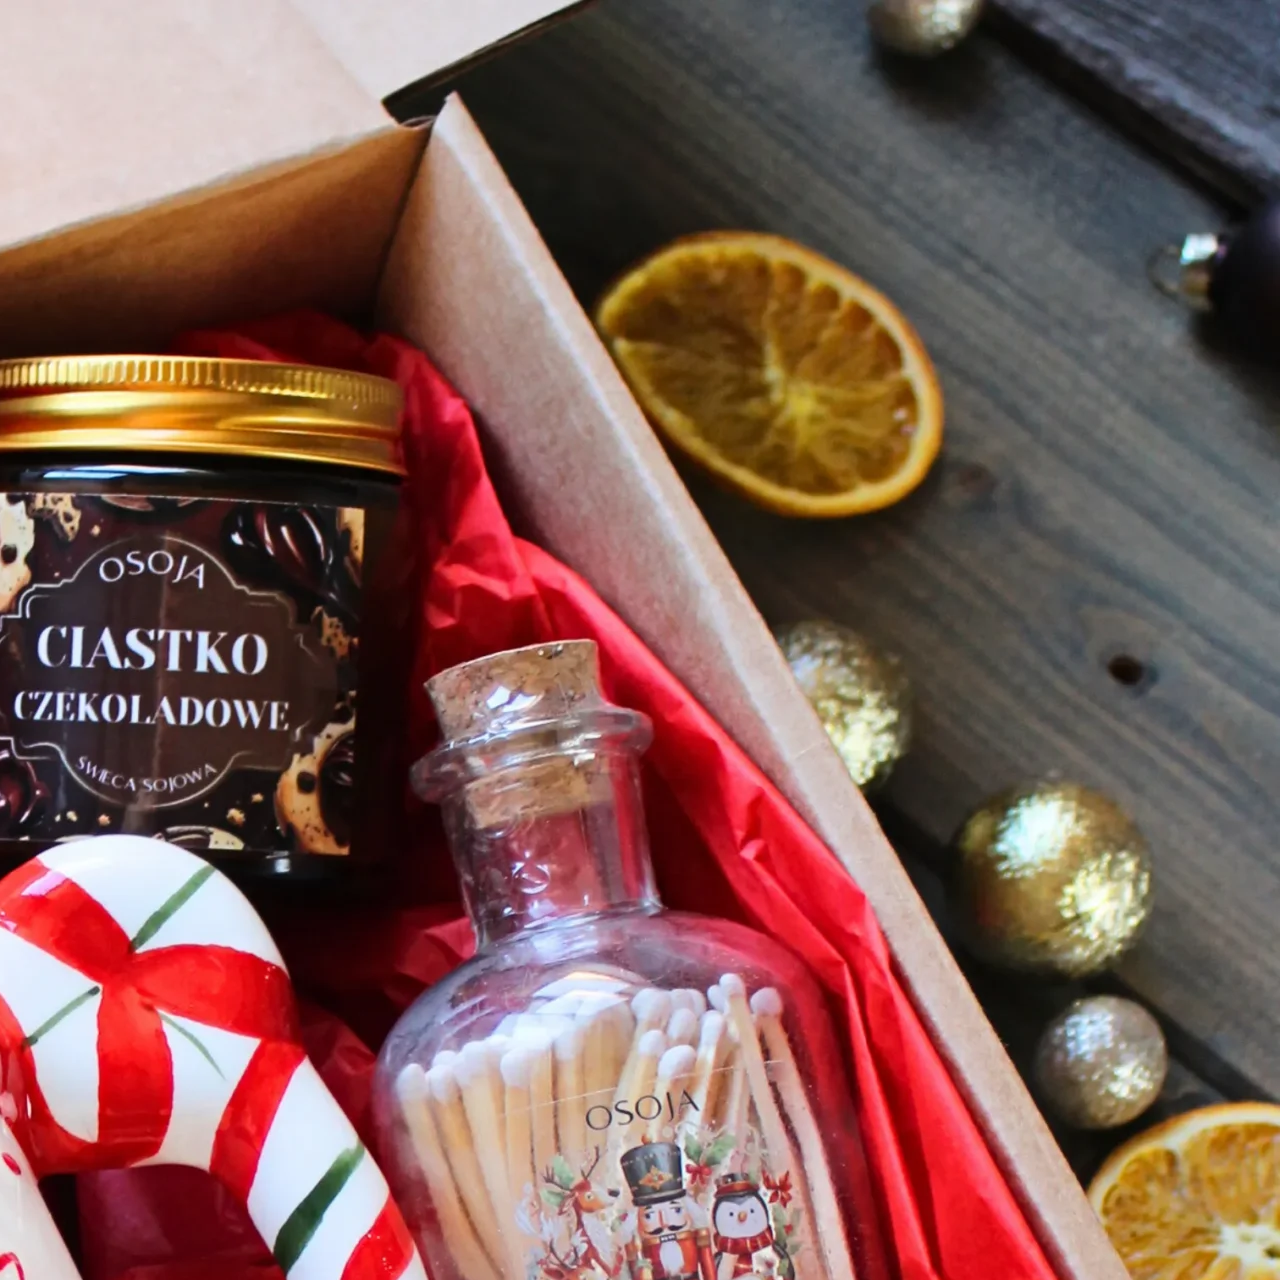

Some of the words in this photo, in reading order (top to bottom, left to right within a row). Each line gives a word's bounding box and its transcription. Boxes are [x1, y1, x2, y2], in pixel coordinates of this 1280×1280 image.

[99, 551, 205, 588] OSOJA
[37, 625, 269, 675] CIASTKO
[13, 691, 290, 731] CZEKOLADOWE
[143, 763, 217, 792] SOJOWA
[586, 1089, 700, 1131] OSOJA
